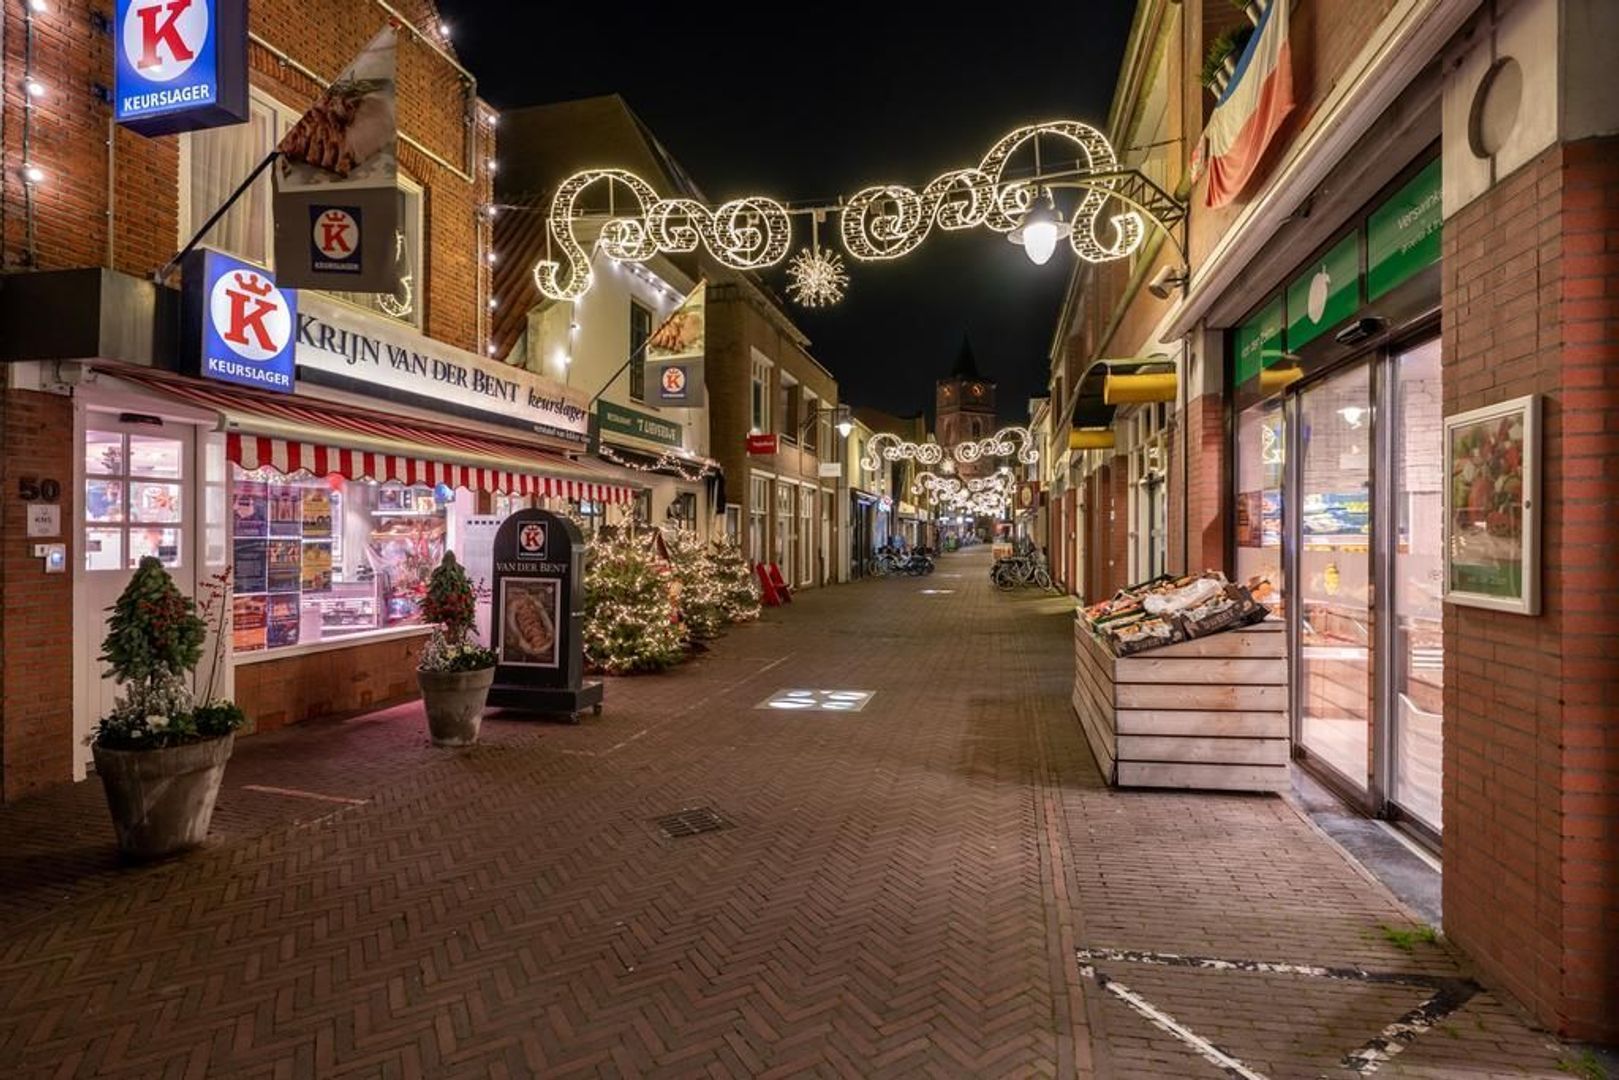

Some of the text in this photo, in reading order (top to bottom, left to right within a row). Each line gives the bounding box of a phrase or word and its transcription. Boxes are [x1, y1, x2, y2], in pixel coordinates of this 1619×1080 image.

[137, 0, 194, 69] K
[124, 84, 210, 112] KEURSLAGER
[321, 223, 351, 252] K
[224, 288, 278, 353] K
[208, 358, 290, 386] KEURSLAGER
[297, 313, 380, 365] KRIJN
[385, 343, 428, 377] VAN
[432, 358, 468, 389] DER
[472, 368, 520, 402] BENT
[528, 386, 587, 423] keurslager
[666, 374, 681, 389] K
[19, 476, 61, 501] 50
[524, 532, 540, 547] K
[496, 562, 568, 573] VAN DER BENT
